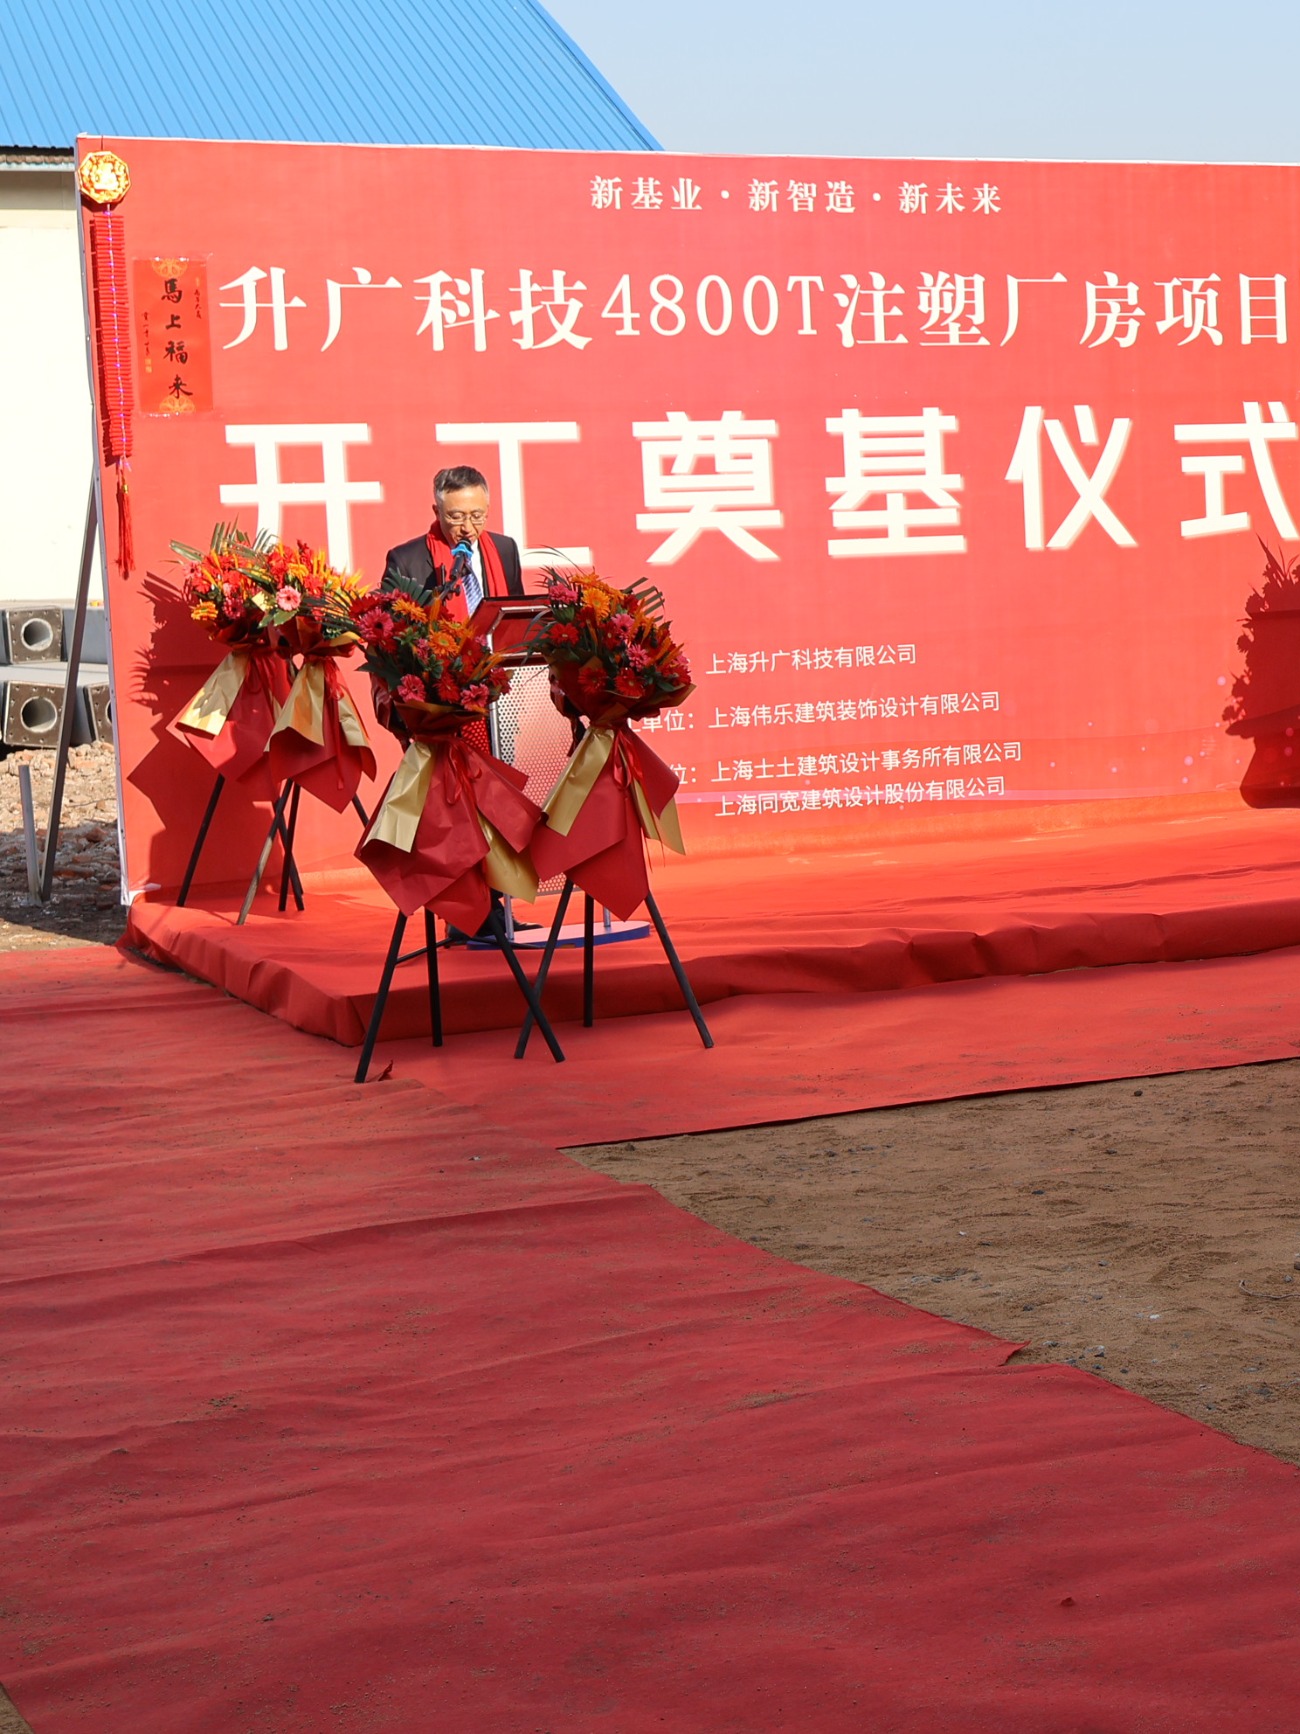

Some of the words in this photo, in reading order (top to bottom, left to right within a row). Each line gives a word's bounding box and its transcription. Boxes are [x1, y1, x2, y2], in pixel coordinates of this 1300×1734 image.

[219, 266, 1288, 352] 升广科技4800T注塑厂房项目
[218, 400, 1300, 575] 开工奠基仪式
[705, 643, 917, 675] 上海升广科技有限公司
[714, 776, 1005, 817] 上海同宽建筑设计股份有限公司
